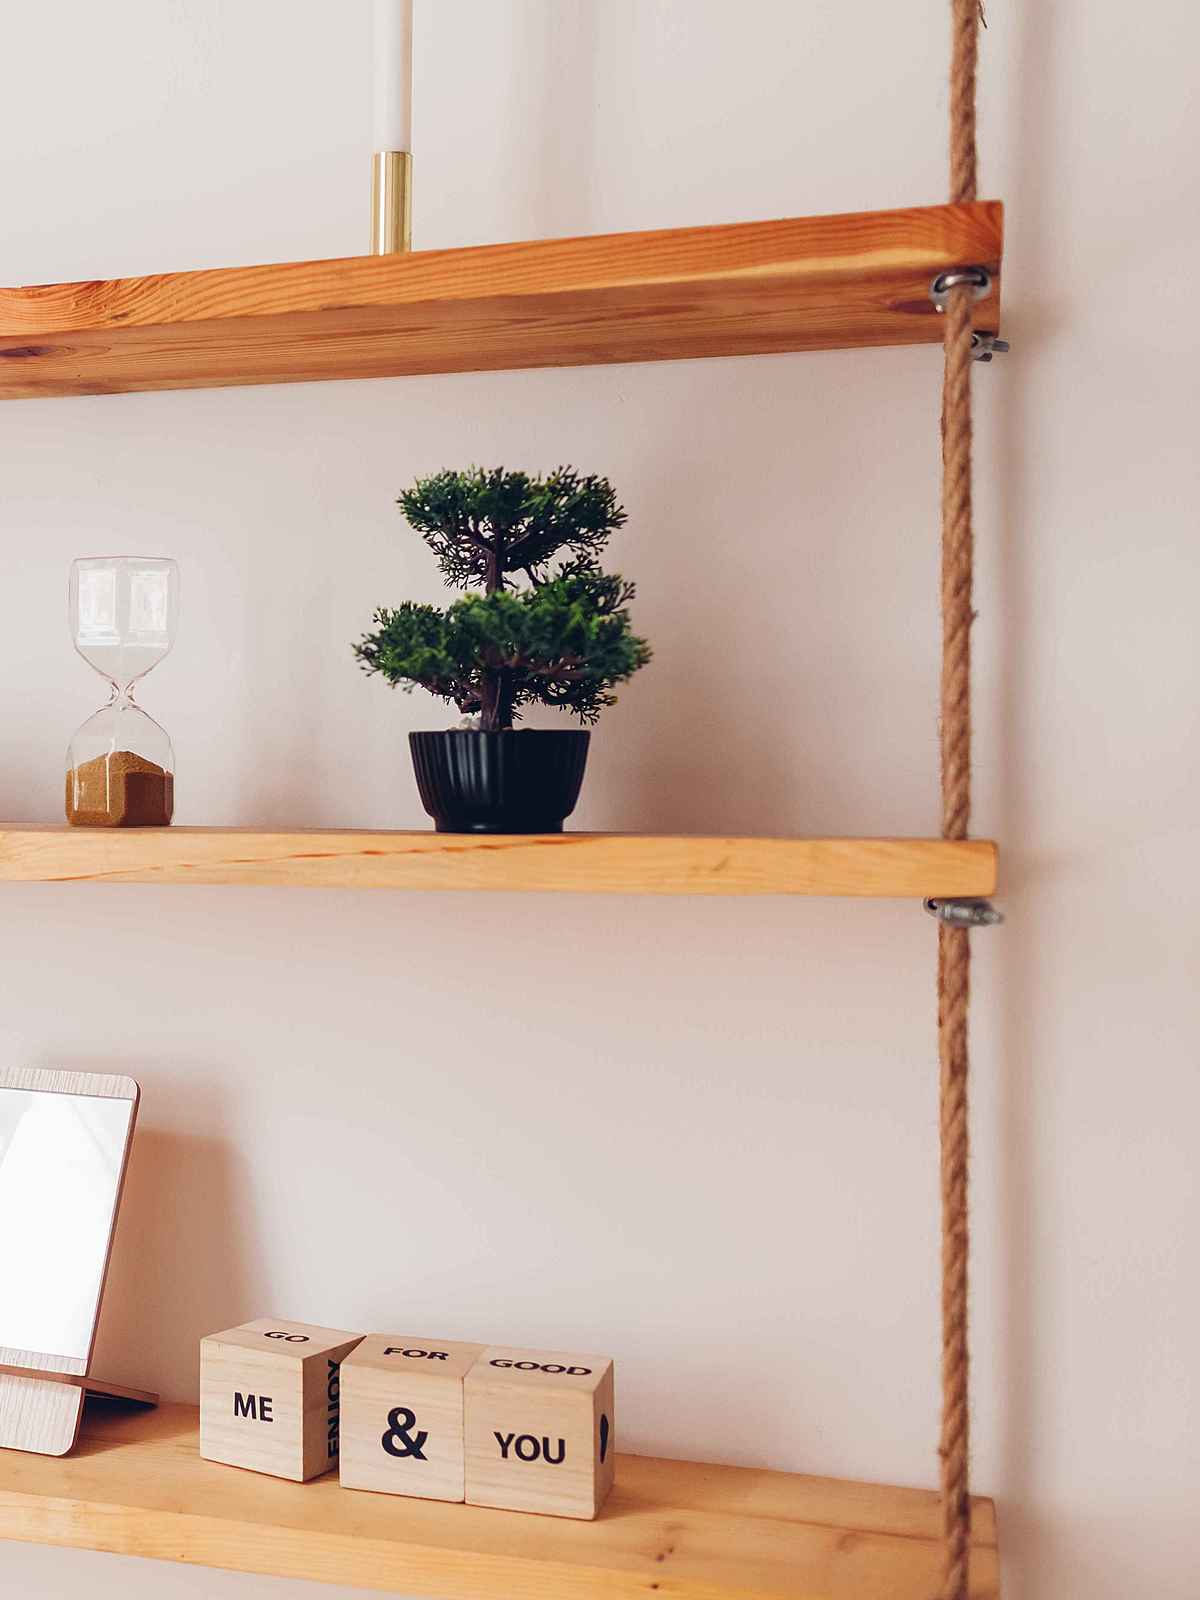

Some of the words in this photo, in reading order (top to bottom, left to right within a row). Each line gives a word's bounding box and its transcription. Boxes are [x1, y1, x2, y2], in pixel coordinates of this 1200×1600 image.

[263, 1331, 310, 1343] GO
[383, 1347, 449, 1361] FOR
[489, 1359, 593, 1376] GOOD
[234, 1391, 274, 1423] ME
[381, 1406, 429, 1461] &
[493, 1431, 566, 1465] YOU
